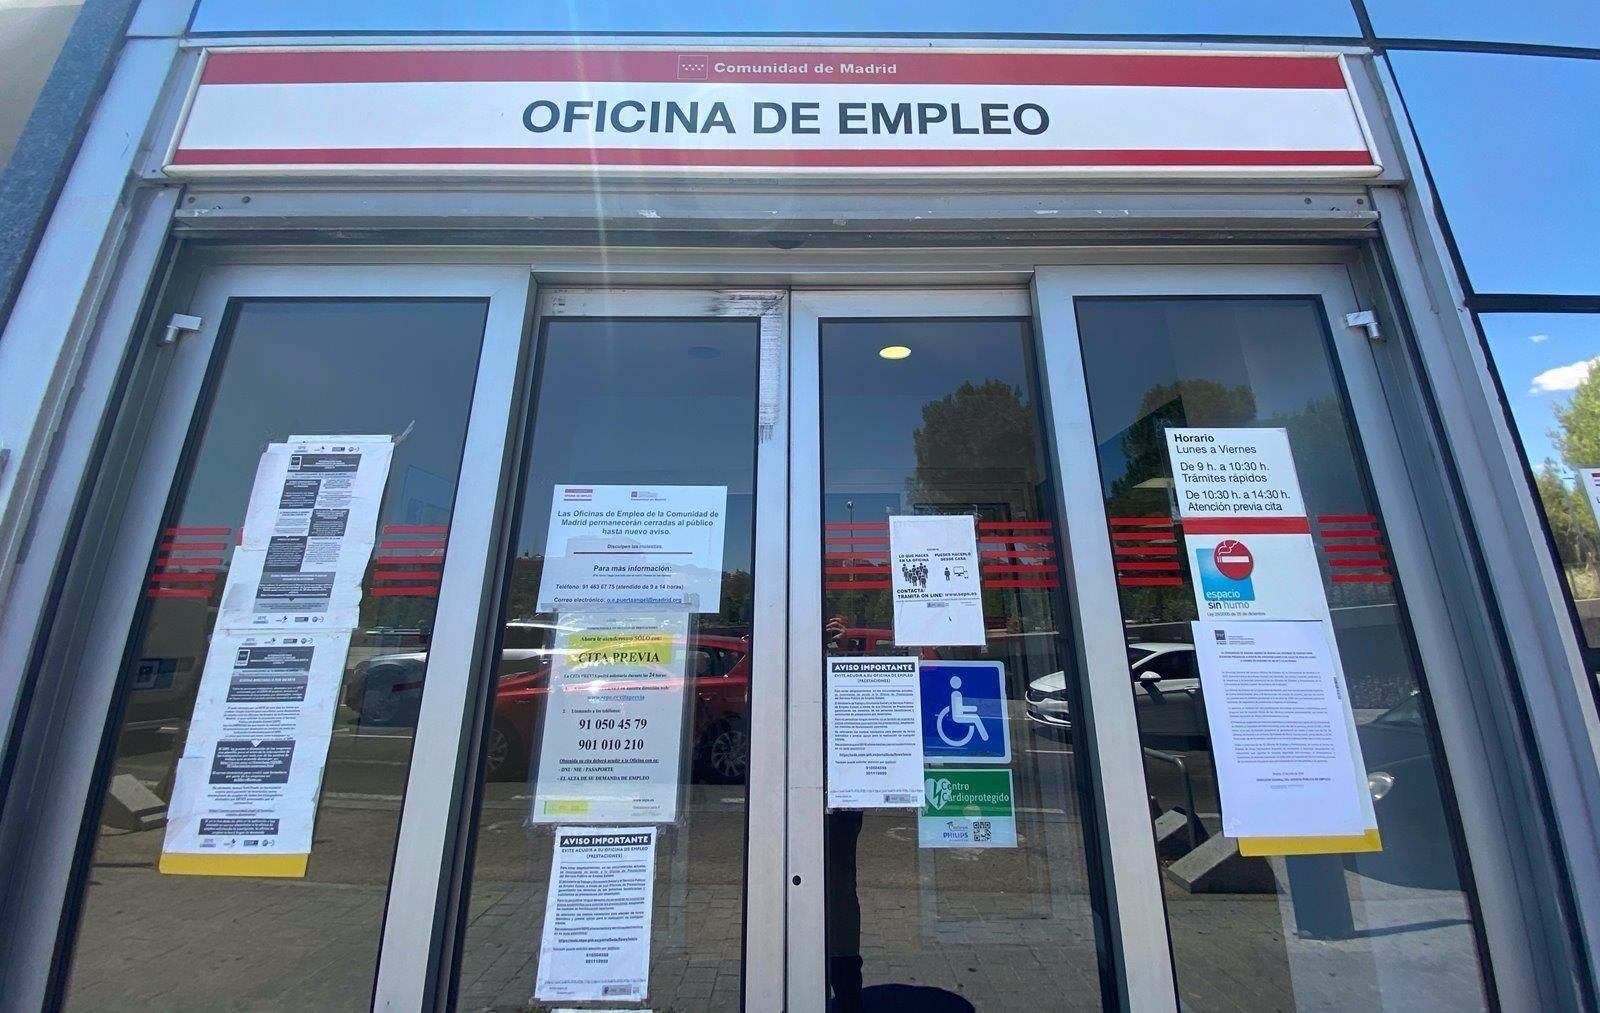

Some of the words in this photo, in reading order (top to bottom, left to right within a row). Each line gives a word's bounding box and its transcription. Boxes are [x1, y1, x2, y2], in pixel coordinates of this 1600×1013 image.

[714, 61, 808, 75] Comunidad
[814, 61, 834, 75] de
[840, 61, 897, 75] Madrid
[522, 100, 737, 134] OFICINA
[754, 102, 820, 134] DE
[839, 102, 1050, 135] EMPLEO
[1174, 433, 1215, 443] Horario
[1176, 445, 1207, 454] Lunes
[1218, 445, 1257, 454] Viernes
[1180, 462, 1194, 471] De
[1197, 462, 1204, 471] 9
[1207, 462, 1216, 471] h.
[1229, 462, 1257, 471] 10:30
[1260, 462, 1270, 471] h.
[1182, 473, 1226, 483] Trámites
[1229, 473, 1267, 485] rápidos
[1186, 491, 1200, 499] De
[1202, 491, 1230, 499] 10:30
[1232, 491, 1241, 499] h.
[1252, 491, 1278, 499] 14:30
[1281, 491, 1291, 499] h.
[1188, 501, 1231, 511] Atención
[1234, 503, 1262, 513] previa
[1265, 502, 1282, 511] cita
[558, 510, 571, 518] Las
[573, 510, 604, 518] Oficinas
[606, 510, 615, 518] de
[617, 510, 645, 518] Empleo
[646, 510, 655, 518] de
[658, 510, 664, 518] la
[666, 510, 708, 518] Comunidad
[709, 510, 719, 518] de
[561, 519, 587, 527] Madrid
[644, 519, 676, 527] cerradas
[677, 519, 684, 527] al
[686, 519, 714, 527] público
[593, 564, 610, 572] Para
[611, 564, 626, 572] más
[627, 564, 672, 572] información:
[1206, 589, 1241, 600] espacio
[1208, 600, 1222, 609] sin
[1223, 600, 1250, 609] humo
[579, 652, 609, 663] CITA
[613, 652, 660, 663] PREVIA
[579, 719, 591, 730] 91
[595, 719, 615, 730] 050
[617, 719, 631, 730] 45
[634, 719, 647, 730] 79
[578, 739, 597, 751] 901
[601, 739, 621, 751] 010
[624, 739, 644, 751] 210
[941, 781, 970, 791] Centro
[941, 792, 1010, 804] Cardioprotegido
[562, 837, 590, 845] AVISO
[591, 836, 649, 845] IMPORTANTE
